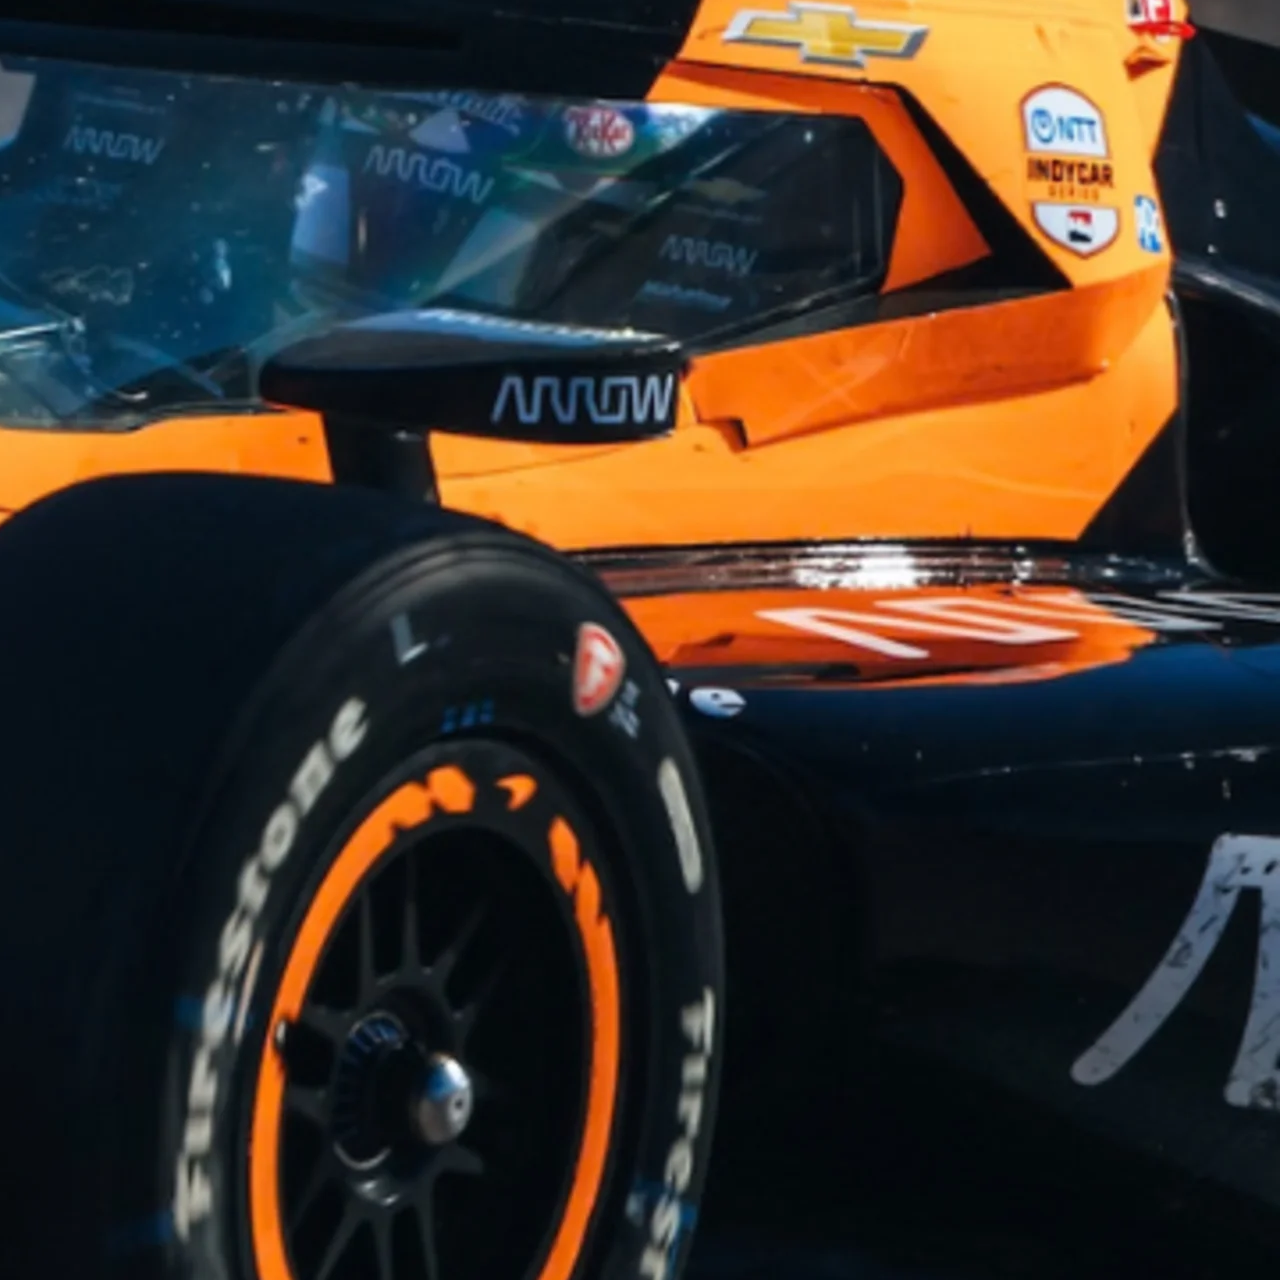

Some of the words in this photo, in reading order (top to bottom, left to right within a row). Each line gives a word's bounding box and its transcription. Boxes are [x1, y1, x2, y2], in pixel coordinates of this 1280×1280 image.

[1057, 116, 1096, 144] NTT
[1027, 158, 1116, 188] INDYCAR
[492, 375, 674, 425] ARROW
[176, 696, 370, 1243] Firestone
